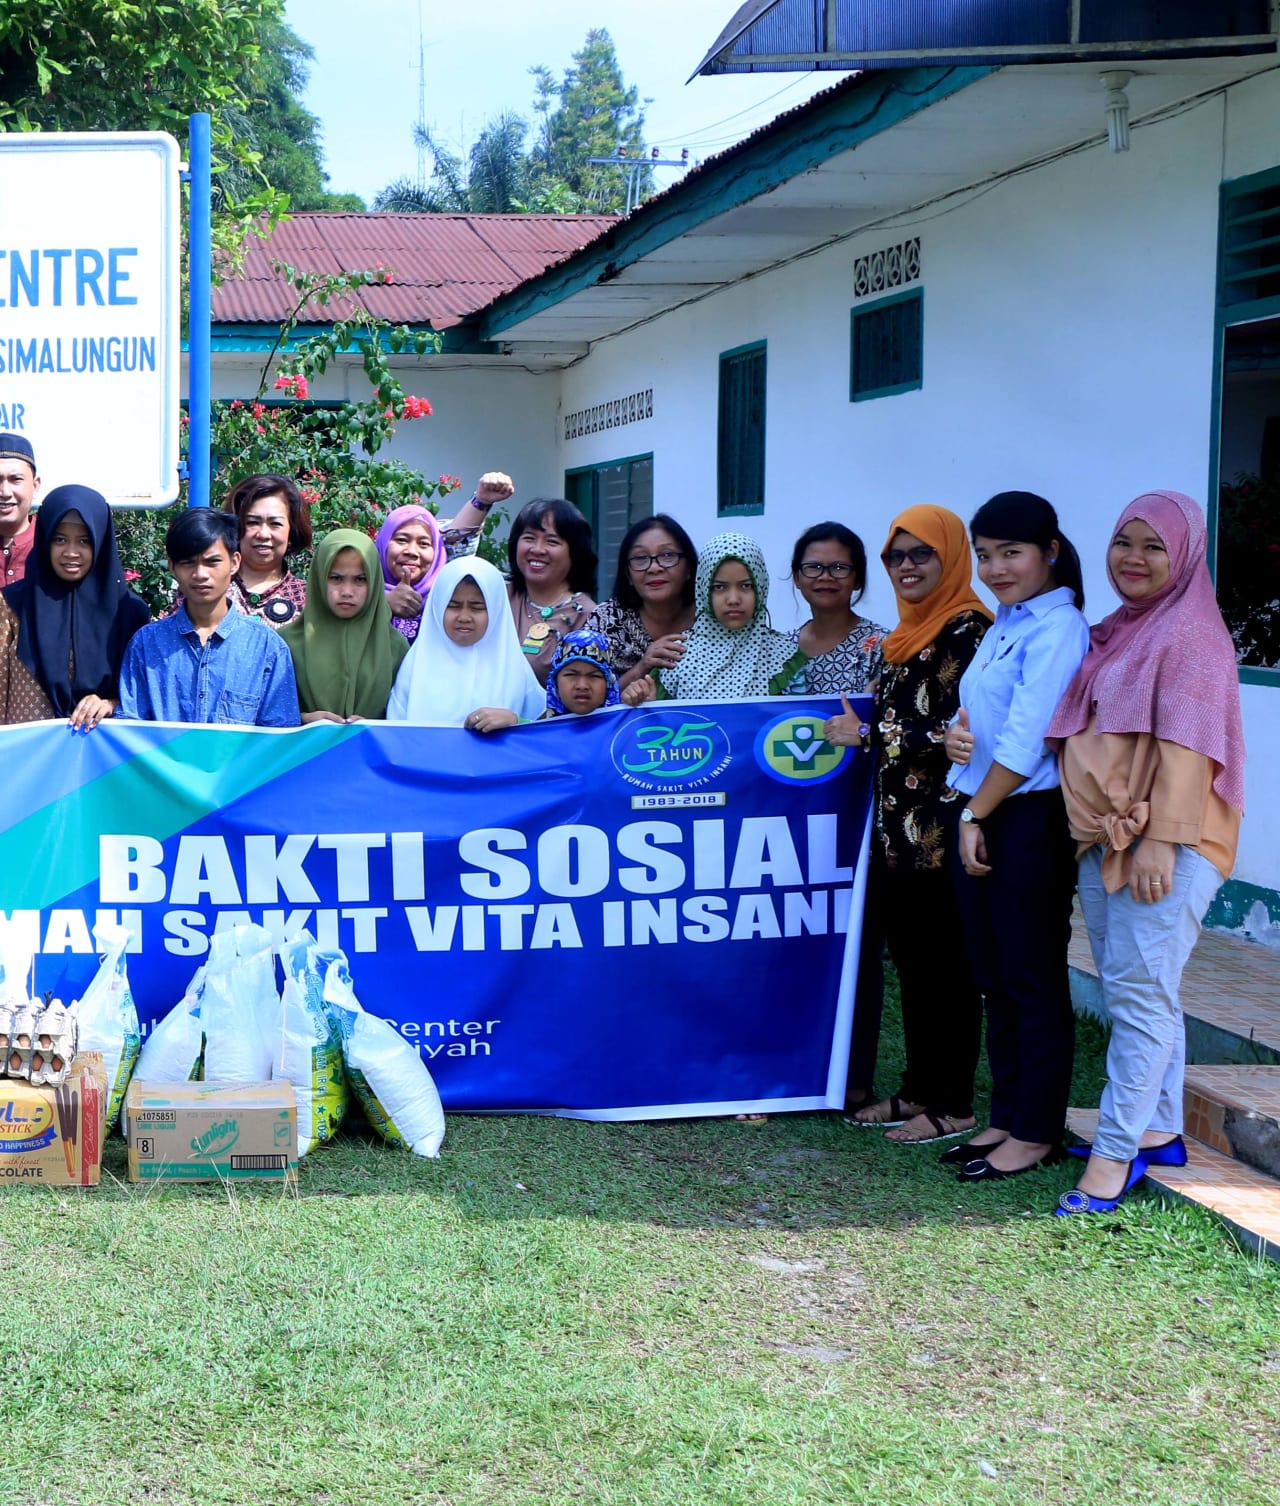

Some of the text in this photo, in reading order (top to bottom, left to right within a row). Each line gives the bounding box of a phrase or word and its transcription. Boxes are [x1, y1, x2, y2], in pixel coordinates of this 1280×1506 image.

[647, 748, 703, 762] TAHUN
[621, 754, 734, 793] RUMAH SAKIT VITA INSANI
[642, 795, 718, 807] 1983-2018
[98, 814, 855, 905] BAKTI SOSIAL
[406, 903, 582, 953] VITA
[604, 888, 853, 948] INSANI
[0, 1124, 32, 1133] STICK
[5, 1138, 46, 1149] HAPPINESS
[141, 1140, 149, 1153] 8
